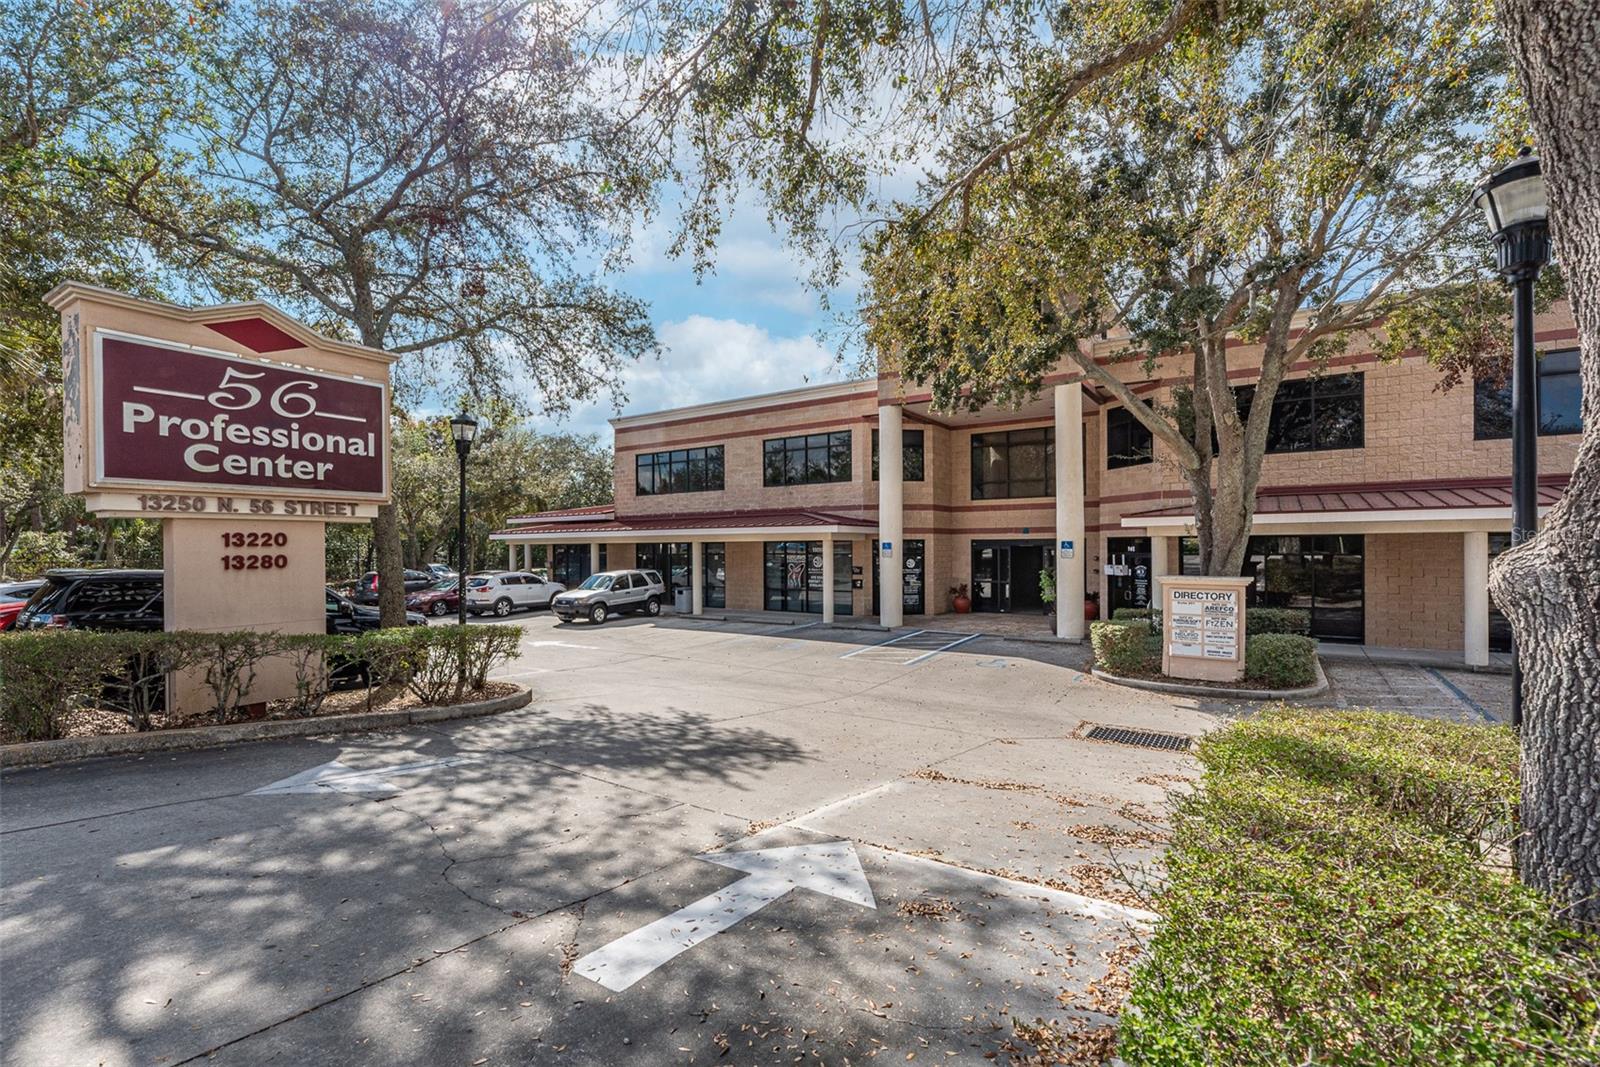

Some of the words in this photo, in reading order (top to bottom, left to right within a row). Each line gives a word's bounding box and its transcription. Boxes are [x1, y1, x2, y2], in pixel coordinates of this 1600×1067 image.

[207, 366, 319, 419] 56
[122, 401, 375, 458] Professional
[183, 443, 334, 481] Center
[137, 495, 206, 513] 13250
[217, 497, 239, 513] N.
[250, 499, 274, 514] 56
[284, 500, 359, 517] STREET
[221, 532, 288, 548] 13220
[221, 554, 288, 571] 13280
[1173, 591, 1233, 601] DIRECTORY
